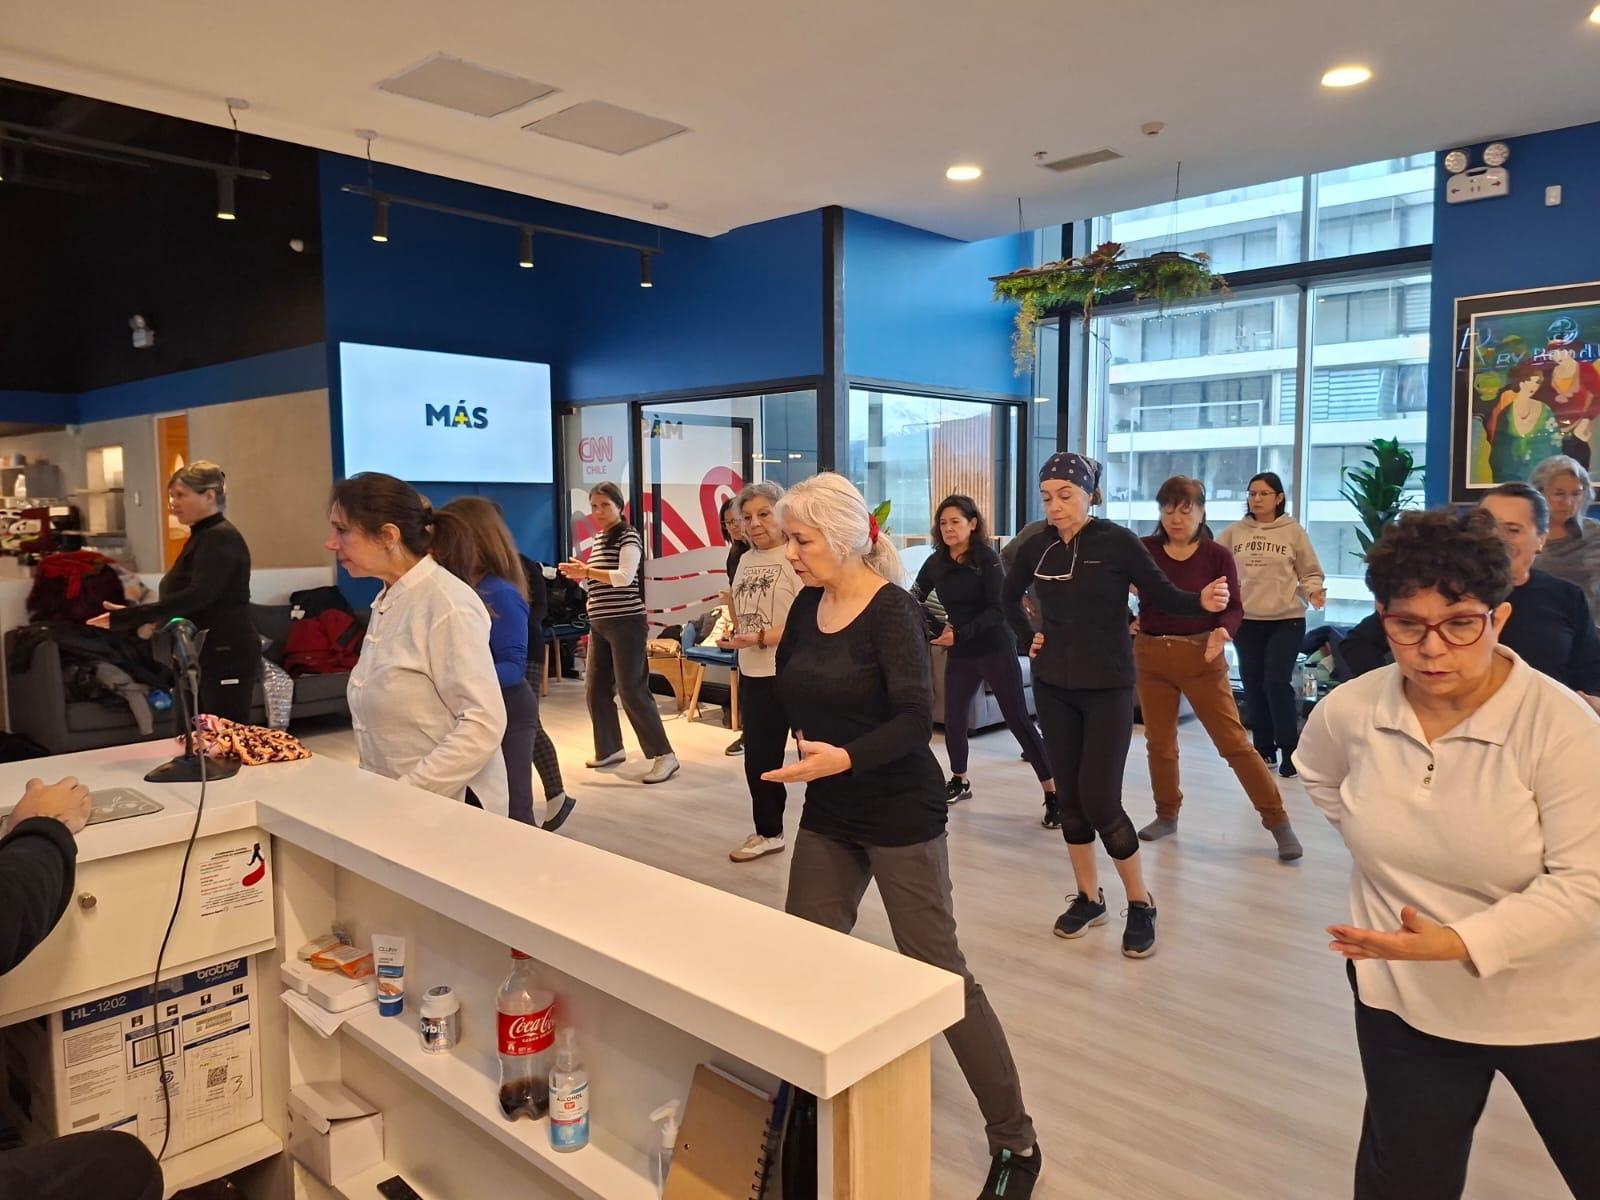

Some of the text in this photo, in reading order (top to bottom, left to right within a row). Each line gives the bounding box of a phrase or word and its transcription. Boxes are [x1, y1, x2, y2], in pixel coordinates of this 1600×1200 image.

[425, 400, 489, 430] MÁS
[579, 436, 613, 463] CNN
[586, 465, 607, 475] CHILE
[1233, 541, 1288, 556] BE POSITIVE
[197, 960, 241, 980] brother
[71, 995, 127, 1021] HL-1202
